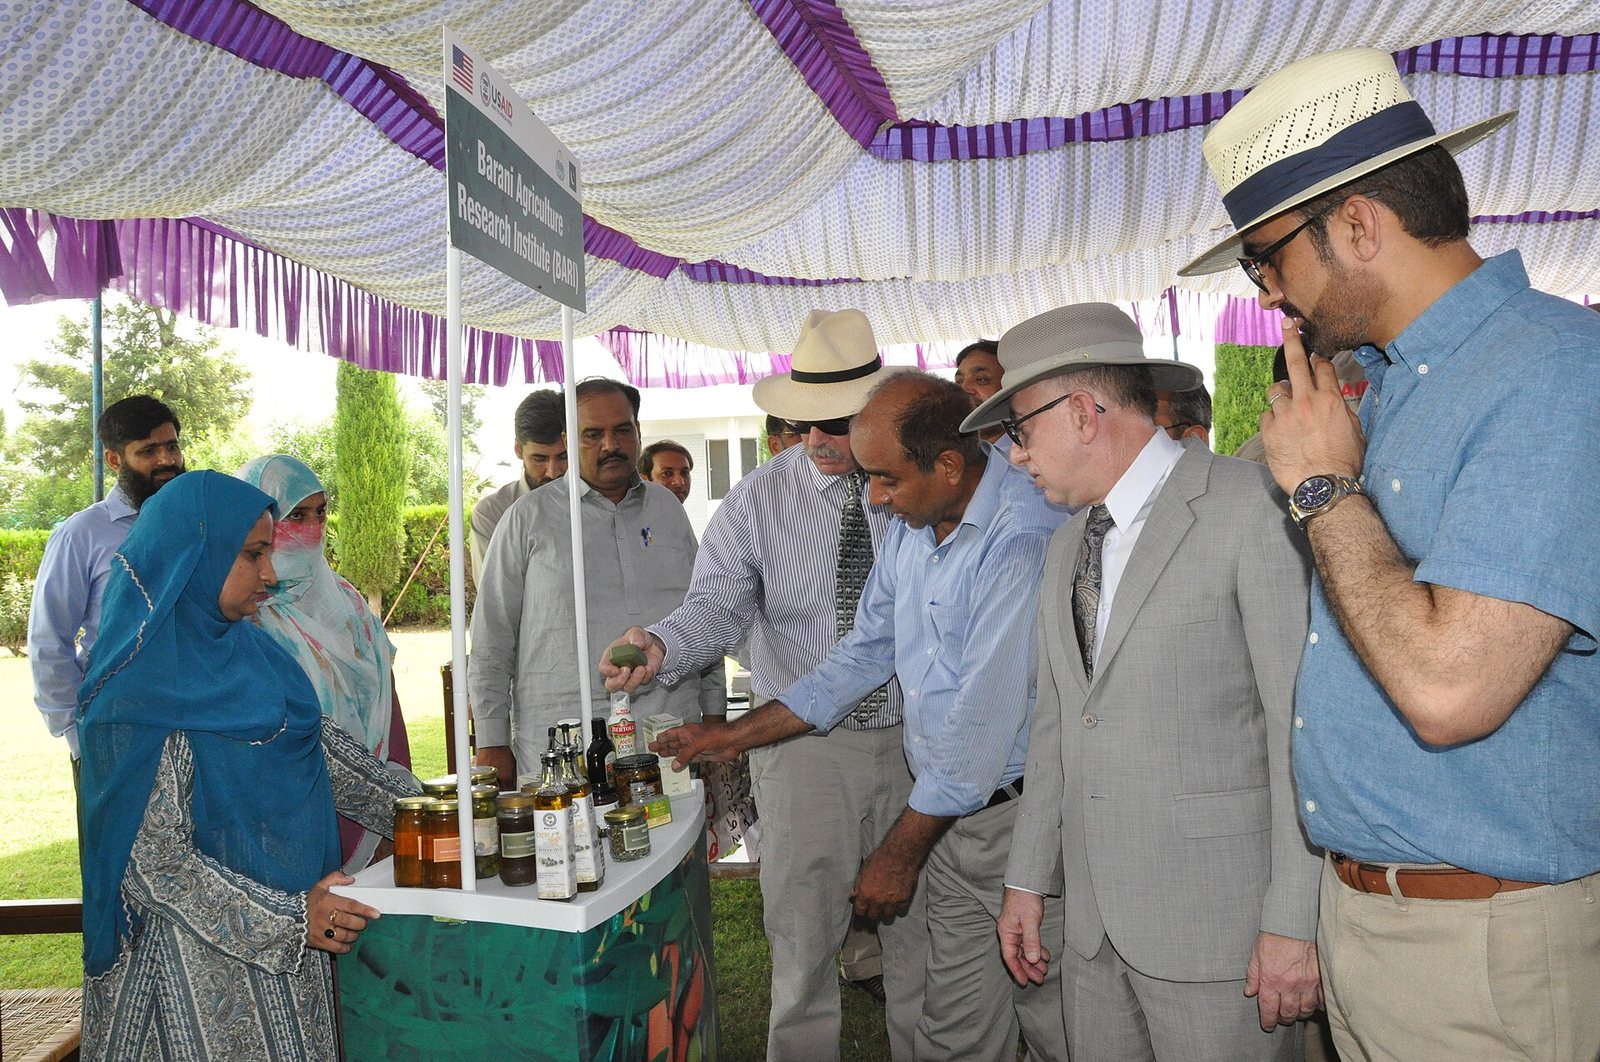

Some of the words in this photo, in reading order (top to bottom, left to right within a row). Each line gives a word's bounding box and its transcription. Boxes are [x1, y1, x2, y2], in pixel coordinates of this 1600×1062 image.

[491, 84, 513, 119] USAID
[477, 139, 514, 198] Barani
[515, 172, 564, 237] Agriculture
[457, 181, 511, 249] Research
[513, 221, 550, 274] Institute
[552, 249, 579, 295] (BARI)
